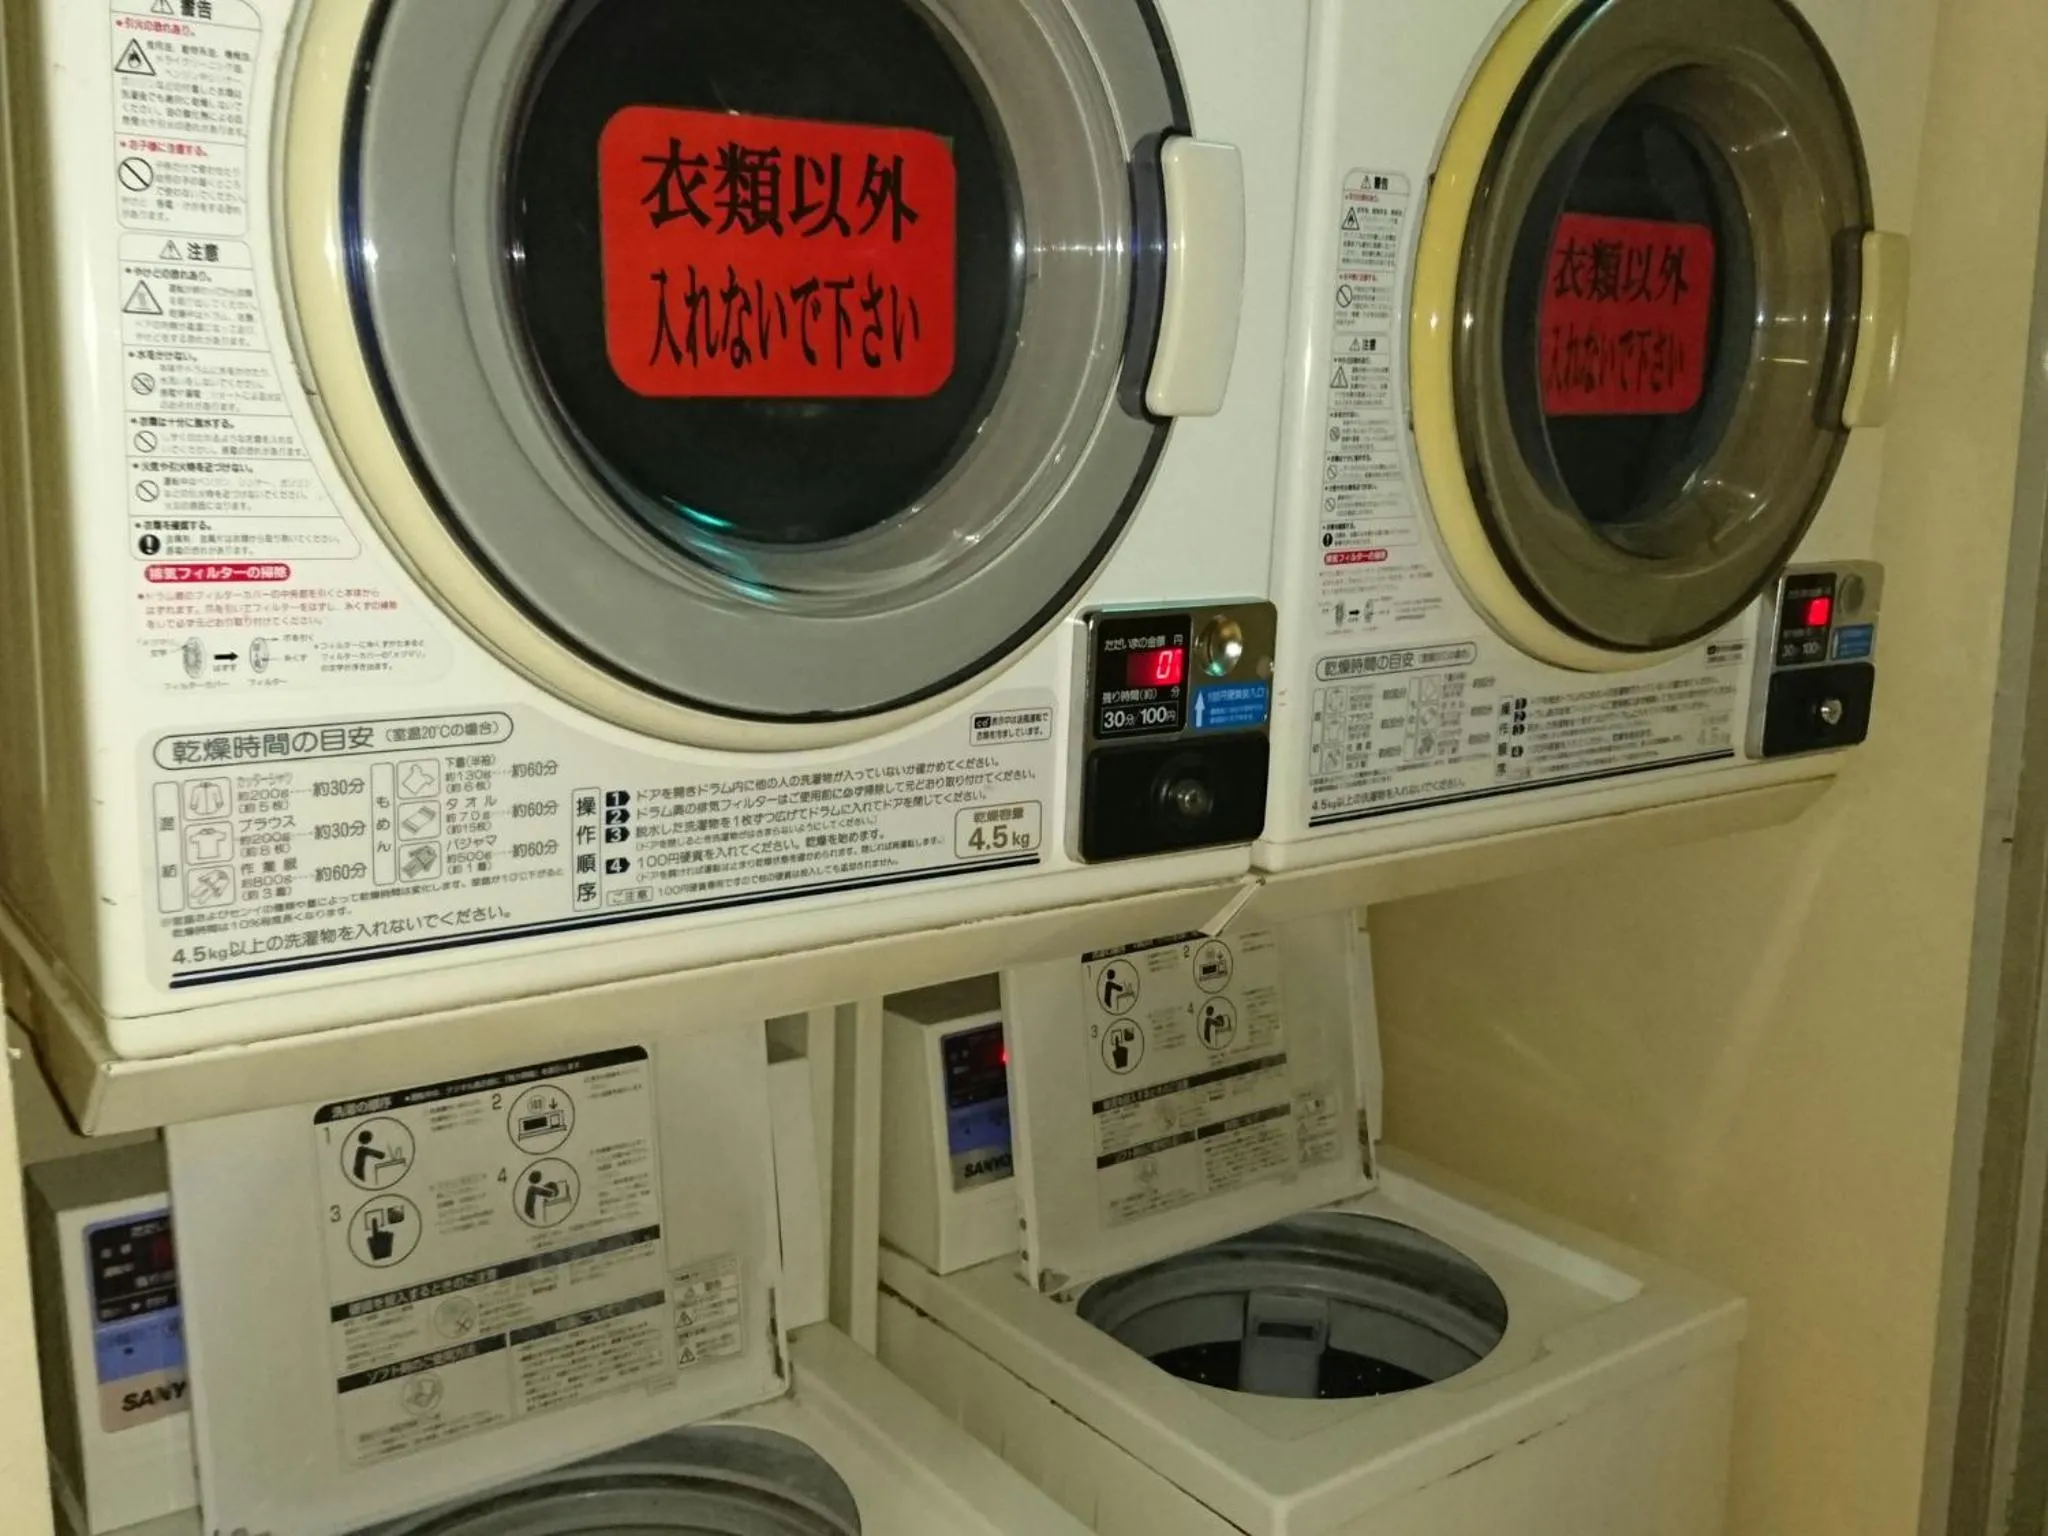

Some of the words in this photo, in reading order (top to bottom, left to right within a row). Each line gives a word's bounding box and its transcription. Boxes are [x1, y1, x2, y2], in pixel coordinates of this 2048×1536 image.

[641, 137, 918, 242] 衣類以外
[187, 242, 219, 262] 注意
[1553, 237, 1688, 304] 衣類以外
[649, 264, 920, 370] 入れないで下さい
[148, 565, 288, 580] 排気フィルターの掃除
[1173, 634, 1184, 646] 円
[1156, 650, 1172, 679] 0
[1171, 686, 1180, 697] 分
[172, 726, 375, 764] 乾燥時間の目安
[511, 760, 558, 778] 約60分
[312, 778, 365, 797] 約30分
[512, 800, 559, 818] 約60分
[974, 807, 1024, 824] 乾燥容量
[239, 815, 297, 832] ブラウス
[314, 820, 366, 840] 約30分
[376, 797, 392, 852] もめん
[968, 824, 1031, 852] 4.5kg
[512, 839, 560, 858] 約60分
[576, 796, 597, 902] 操作順序
[315, 862, 367, 883] 約60分
[172, 906, 511, 965] 4.5kg以上の洗濯物を入れないでください。
[491, 1093, 502, 1111] 2
[323, 1126, 331, 1145] 1
[497, 1167, 507, 1184] 4
[329, 1205, 341, 1223] 3
